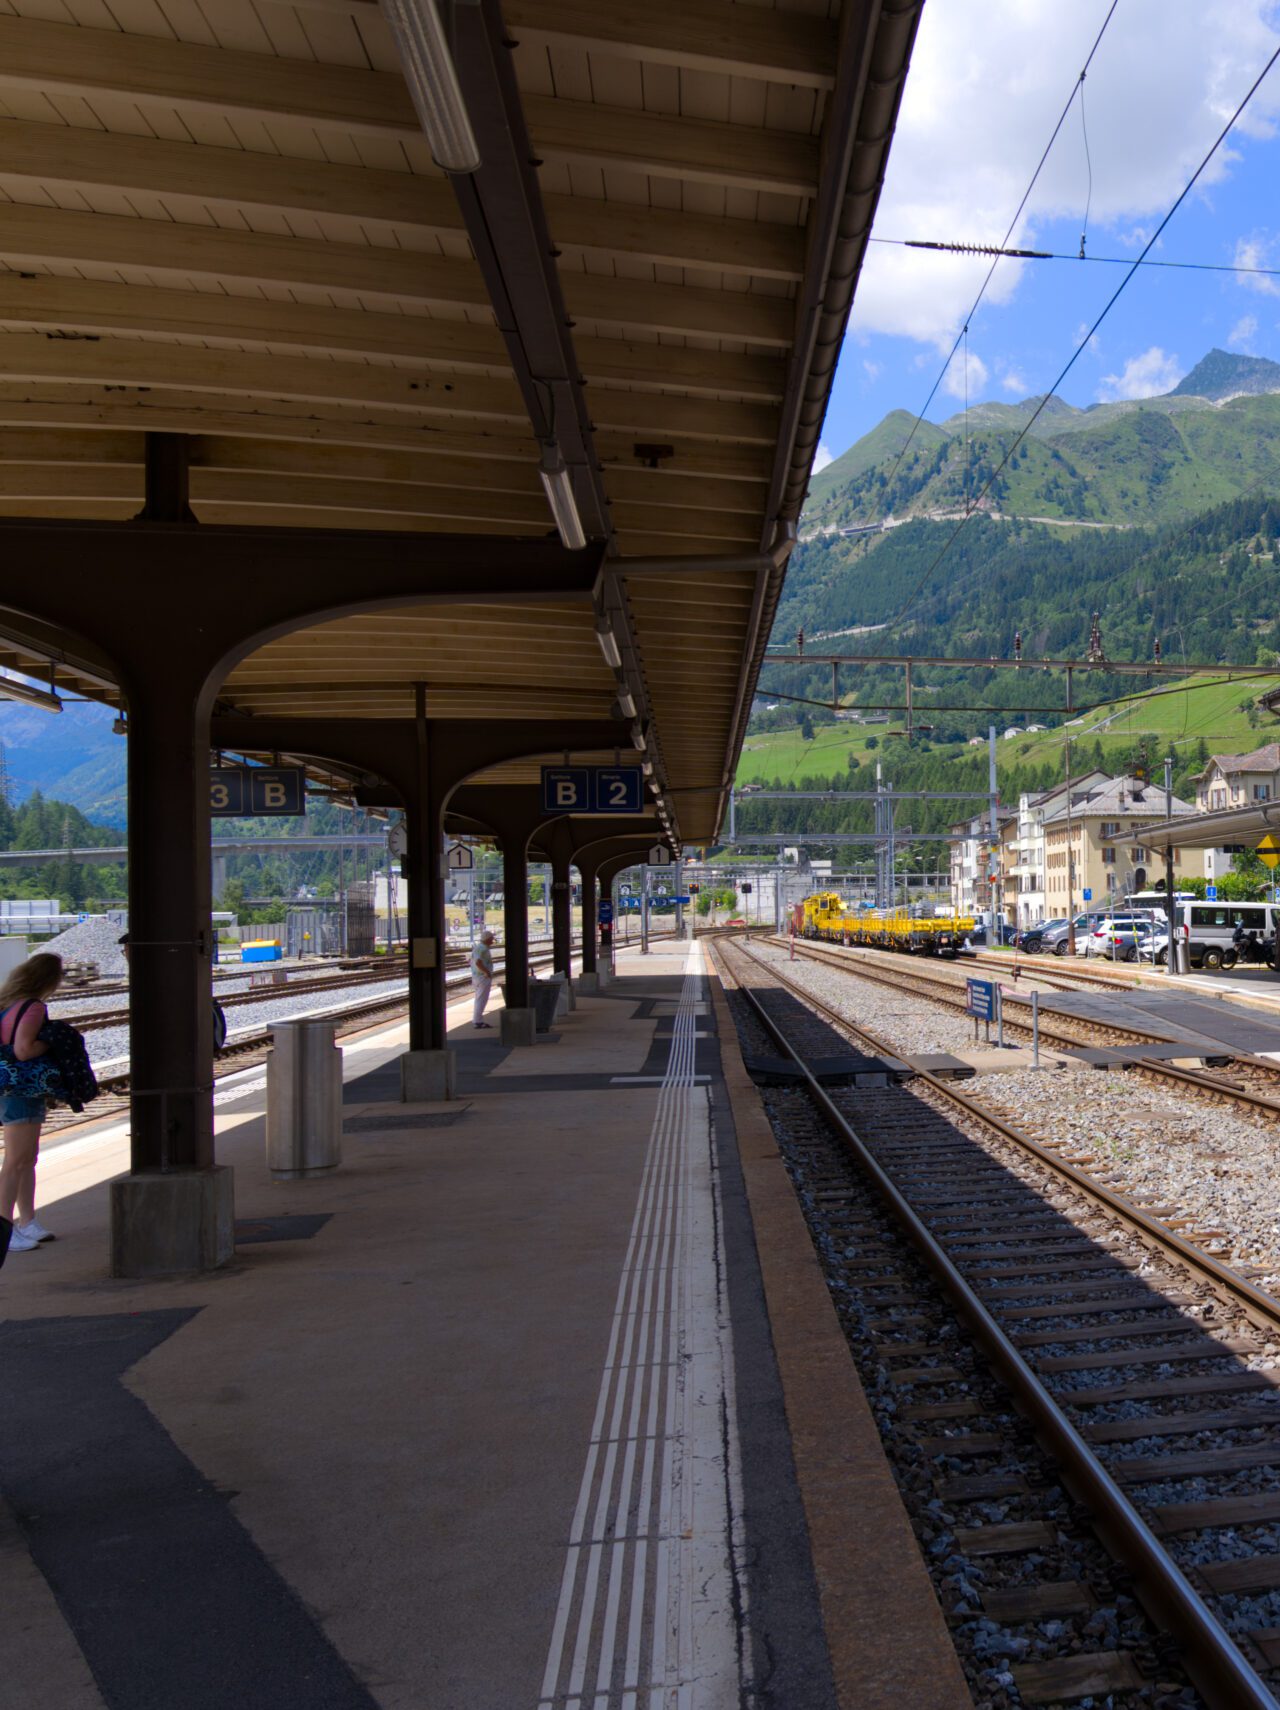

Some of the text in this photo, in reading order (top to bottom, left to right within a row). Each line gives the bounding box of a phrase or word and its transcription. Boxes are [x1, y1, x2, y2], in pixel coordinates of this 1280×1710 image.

[210, 783, 287, 808] 3 B
[556, 782, 627, 805] B 2
[456, 850, 462, 866] 1
[656, 847, 661, 863] 1
